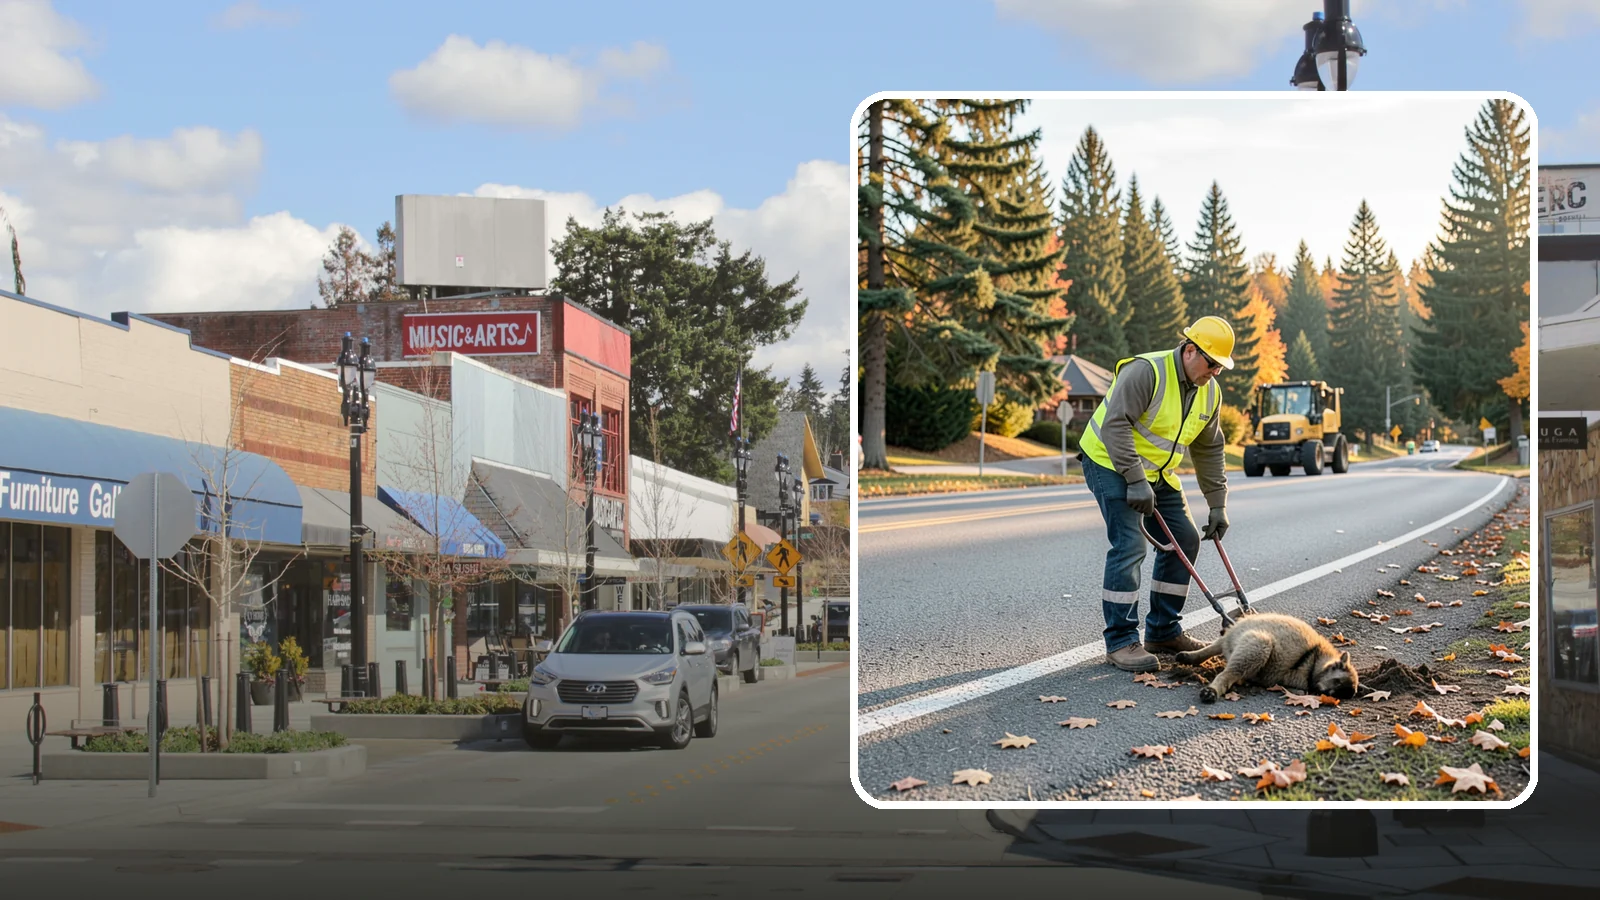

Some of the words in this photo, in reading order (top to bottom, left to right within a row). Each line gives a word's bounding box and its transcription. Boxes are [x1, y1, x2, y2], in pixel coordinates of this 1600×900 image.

[409, 322, 520, 349] MUSIC&ARTS
[0, 471, 79, 515] Furniture
[453, 563, 479, 574] SUSHI
